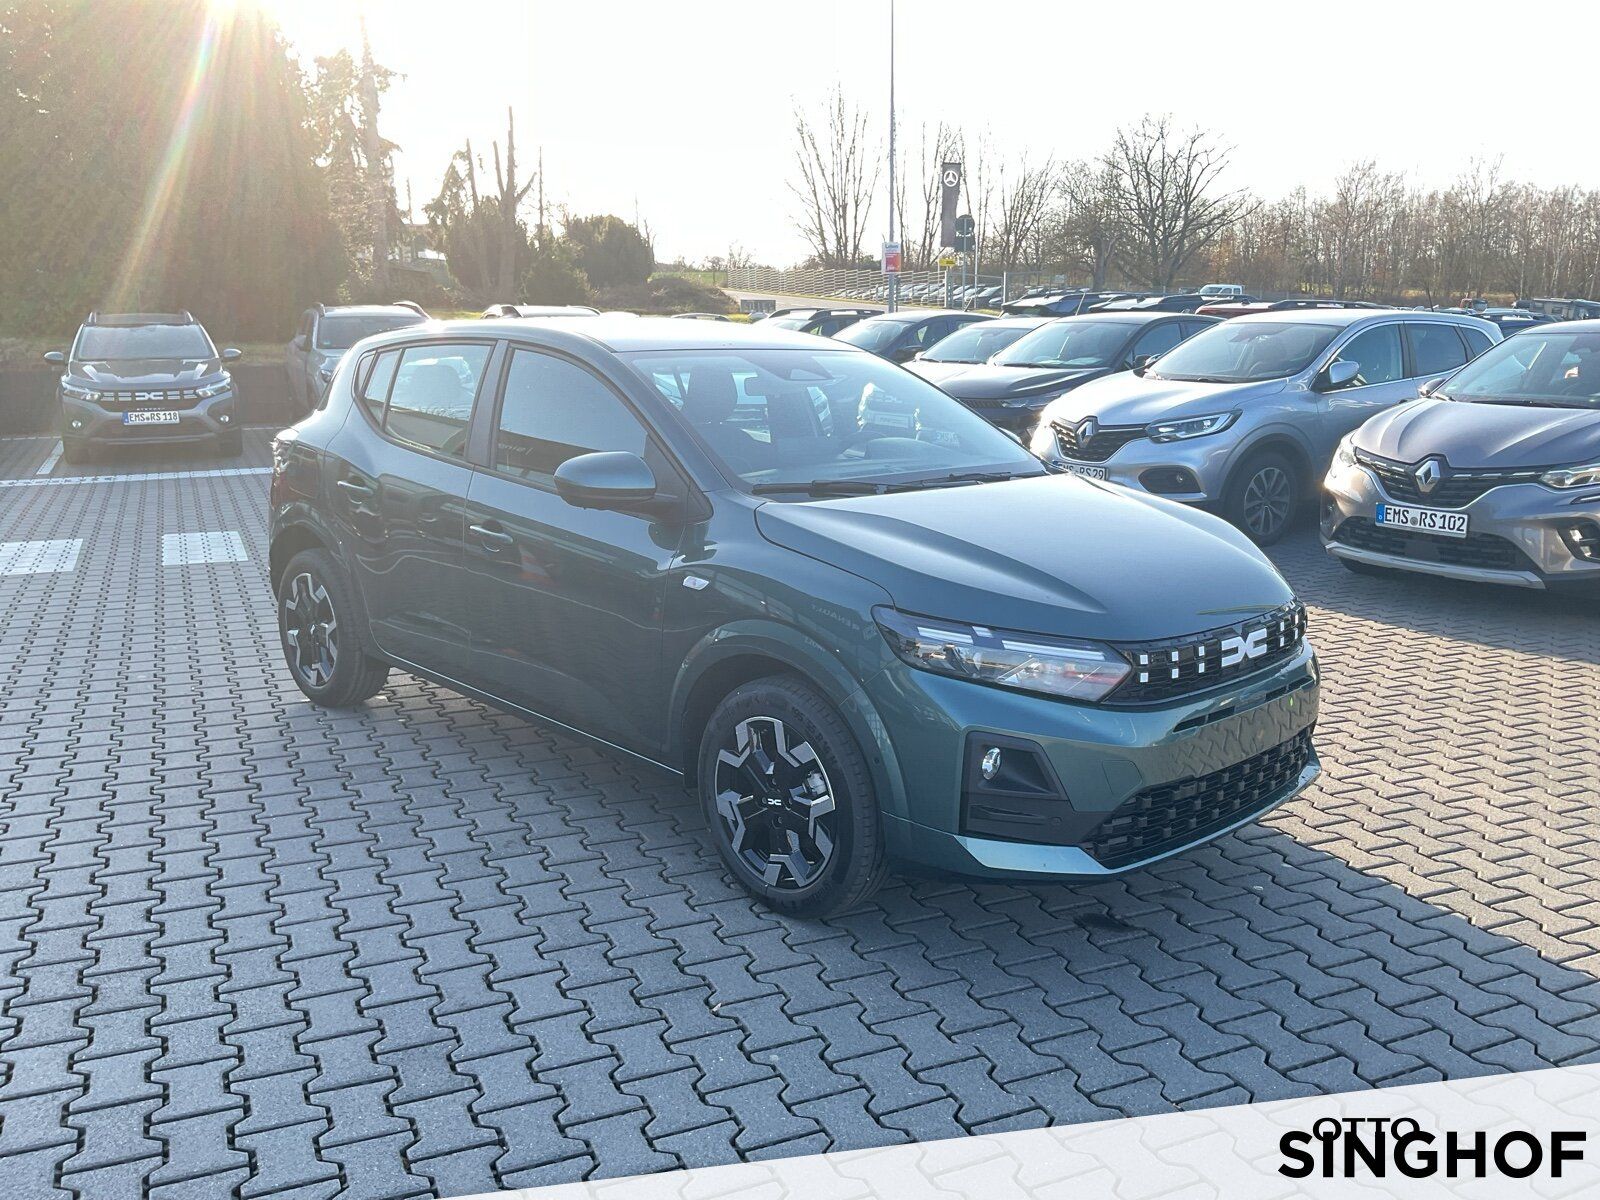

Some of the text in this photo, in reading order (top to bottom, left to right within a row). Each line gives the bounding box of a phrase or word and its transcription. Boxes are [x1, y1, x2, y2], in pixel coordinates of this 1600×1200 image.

[129, 411, 178, 422] EMS RS 118
[1385, 507, 1410, 525] EMS
